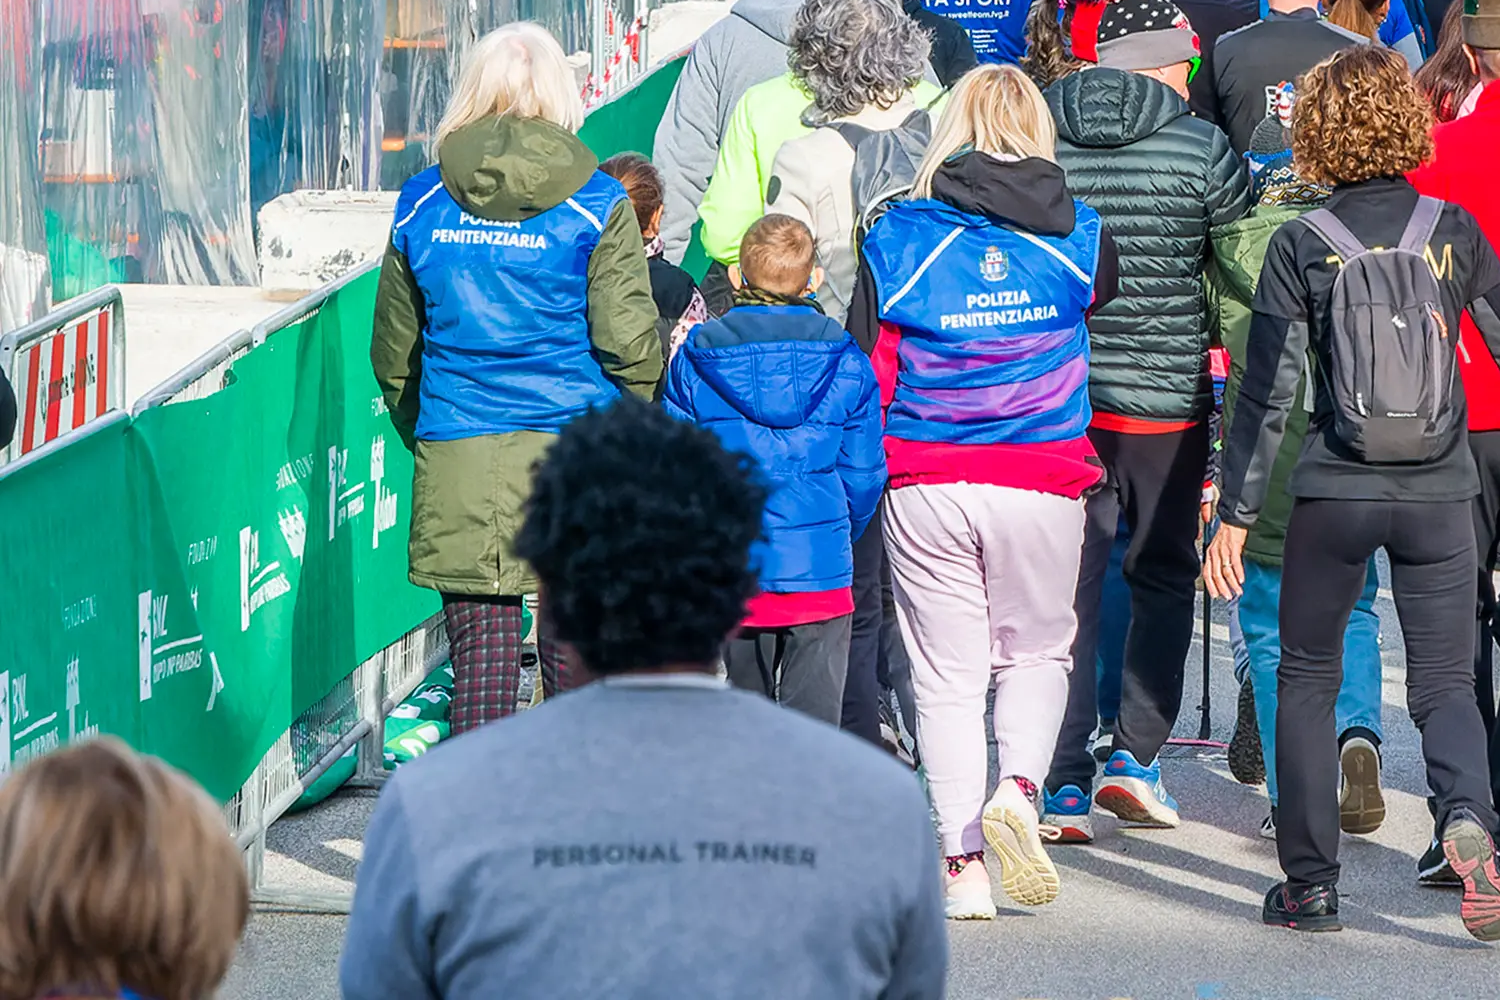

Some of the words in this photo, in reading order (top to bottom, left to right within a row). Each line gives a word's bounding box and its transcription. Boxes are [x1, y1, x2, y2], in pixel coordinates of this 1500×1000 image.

[432, 228, 547, 249] PENITENZIARIA
[966, 289, 1031, 308] POLIZIA
[940, 304, 1059, 330] PENITENZIARIA
[532, 841, 685, 869] PERSONAL
[695, 841, 817, 869] TRAINER
